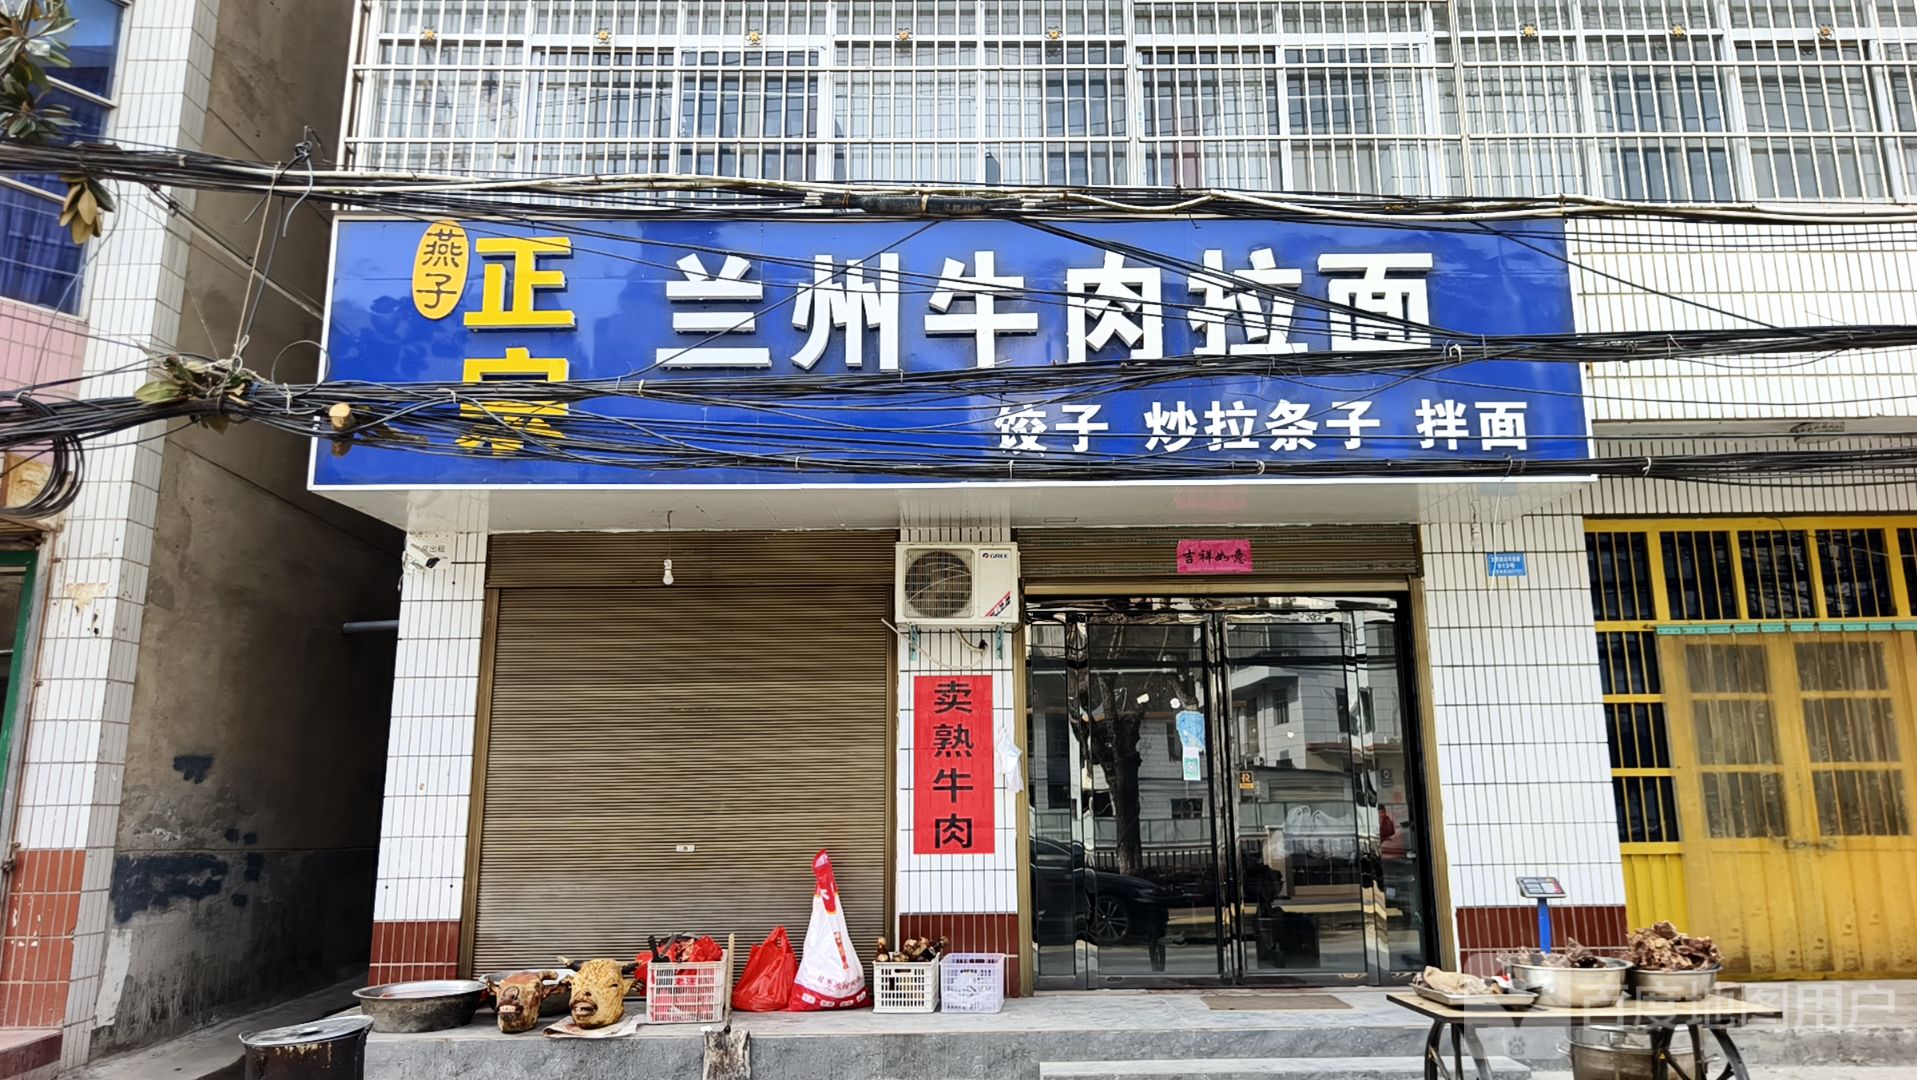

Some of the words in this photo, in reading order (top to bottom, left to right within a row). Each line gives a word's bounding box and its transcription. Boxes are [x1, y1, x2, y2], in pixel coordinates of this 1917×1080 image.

[416, 229, 464, 309] 燕子
[655, 249, 1434, 373] 兰州牛肉拉面
[993, 403, 1109, 457] 饺子
[1145, 400, 1381, 453] 炒拉条子
[1415, 399, 1529, 451] 拌面
[1182, 547, 1246, 564] 吉祥如意
[932, 680, 975, 849] 卖熟牛肉
